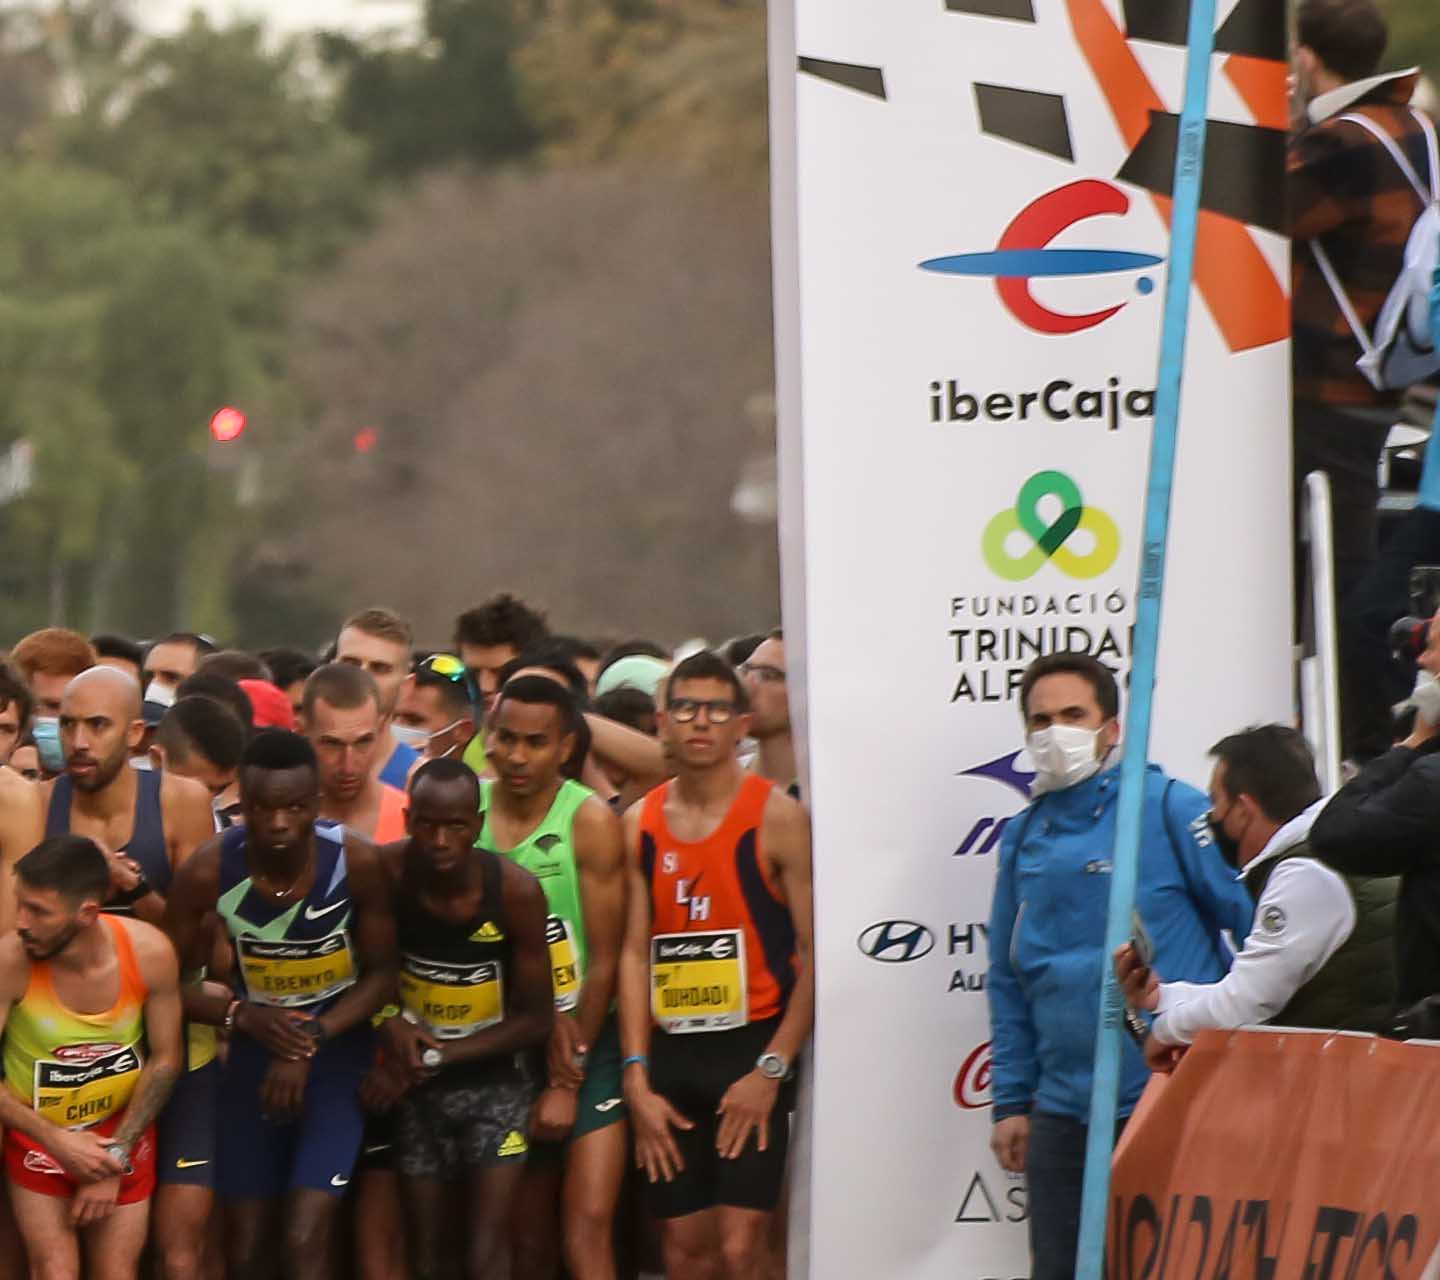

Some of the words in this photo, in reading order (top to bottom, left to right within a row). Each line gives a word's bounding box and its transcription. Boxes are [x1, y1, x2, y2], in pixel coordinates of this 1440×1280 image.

[930, 376, 1158, 431] iberCaja
[951, 587, 1128, 617] FUNDACIÓ
[66, 1094, 113, 1121] CHIKI
